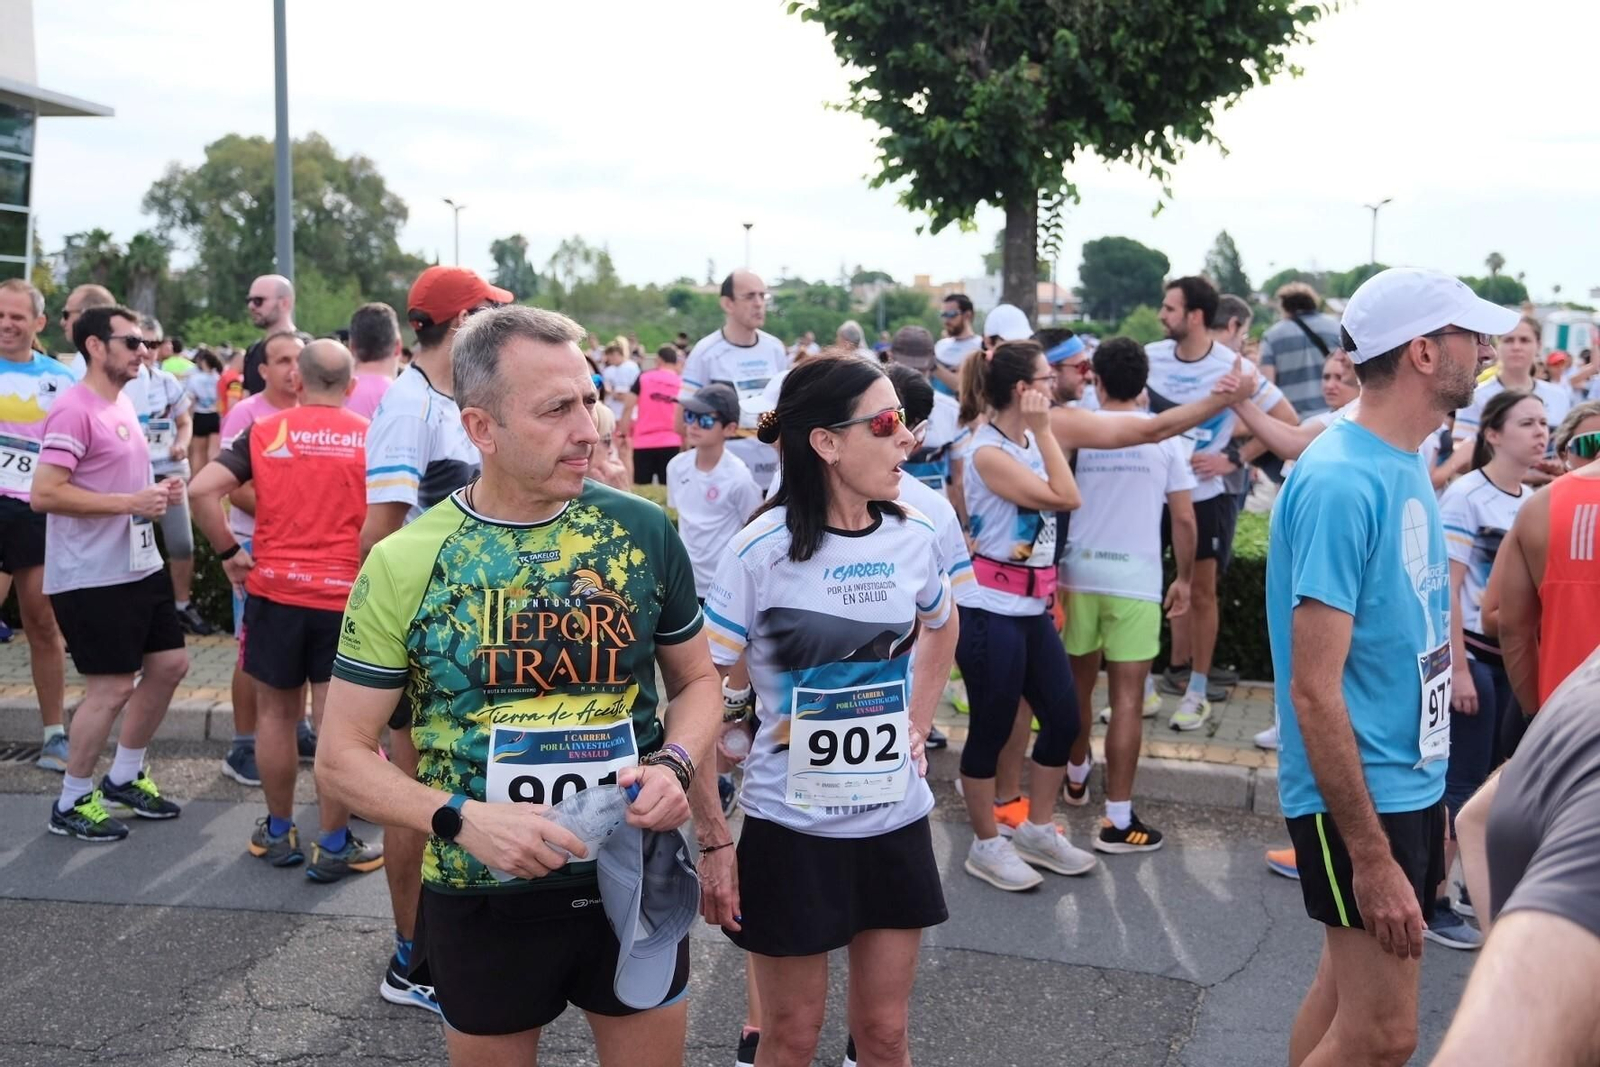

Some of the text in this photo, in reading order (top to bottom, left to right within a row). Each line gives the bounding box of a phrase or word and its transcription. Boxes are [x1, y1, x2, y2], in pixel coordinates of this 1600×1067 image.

[290, 428, 367, 447] verticali
[529, 551, 560, 561] TAKELOT
[832, 562, 895, 582] CARRERA
[827, 586, 842, 595] POR
[843, 585, 853, 593] LA
[842, 590, 888, 605] EN SALUD
[509, 598, 582, 608] MONTORO
[508, 603, 637, 648] EPORA
[476, 647, 632, 691] TRAIL
[856, 690, 885, 699] CARRERA
[477, 705, 544, 724] Tierra
[547, 702, 572, 725] de
[559, 743, 570, 751] LA
[571, 737, 626, 750] INVESTIGACIÓN
[571, 733, 611, 742] CARRERA
[808, 723, 900, 767] 902
[580, 750, 609, 758] SALUD
[508, 771, 617, 807] 90
